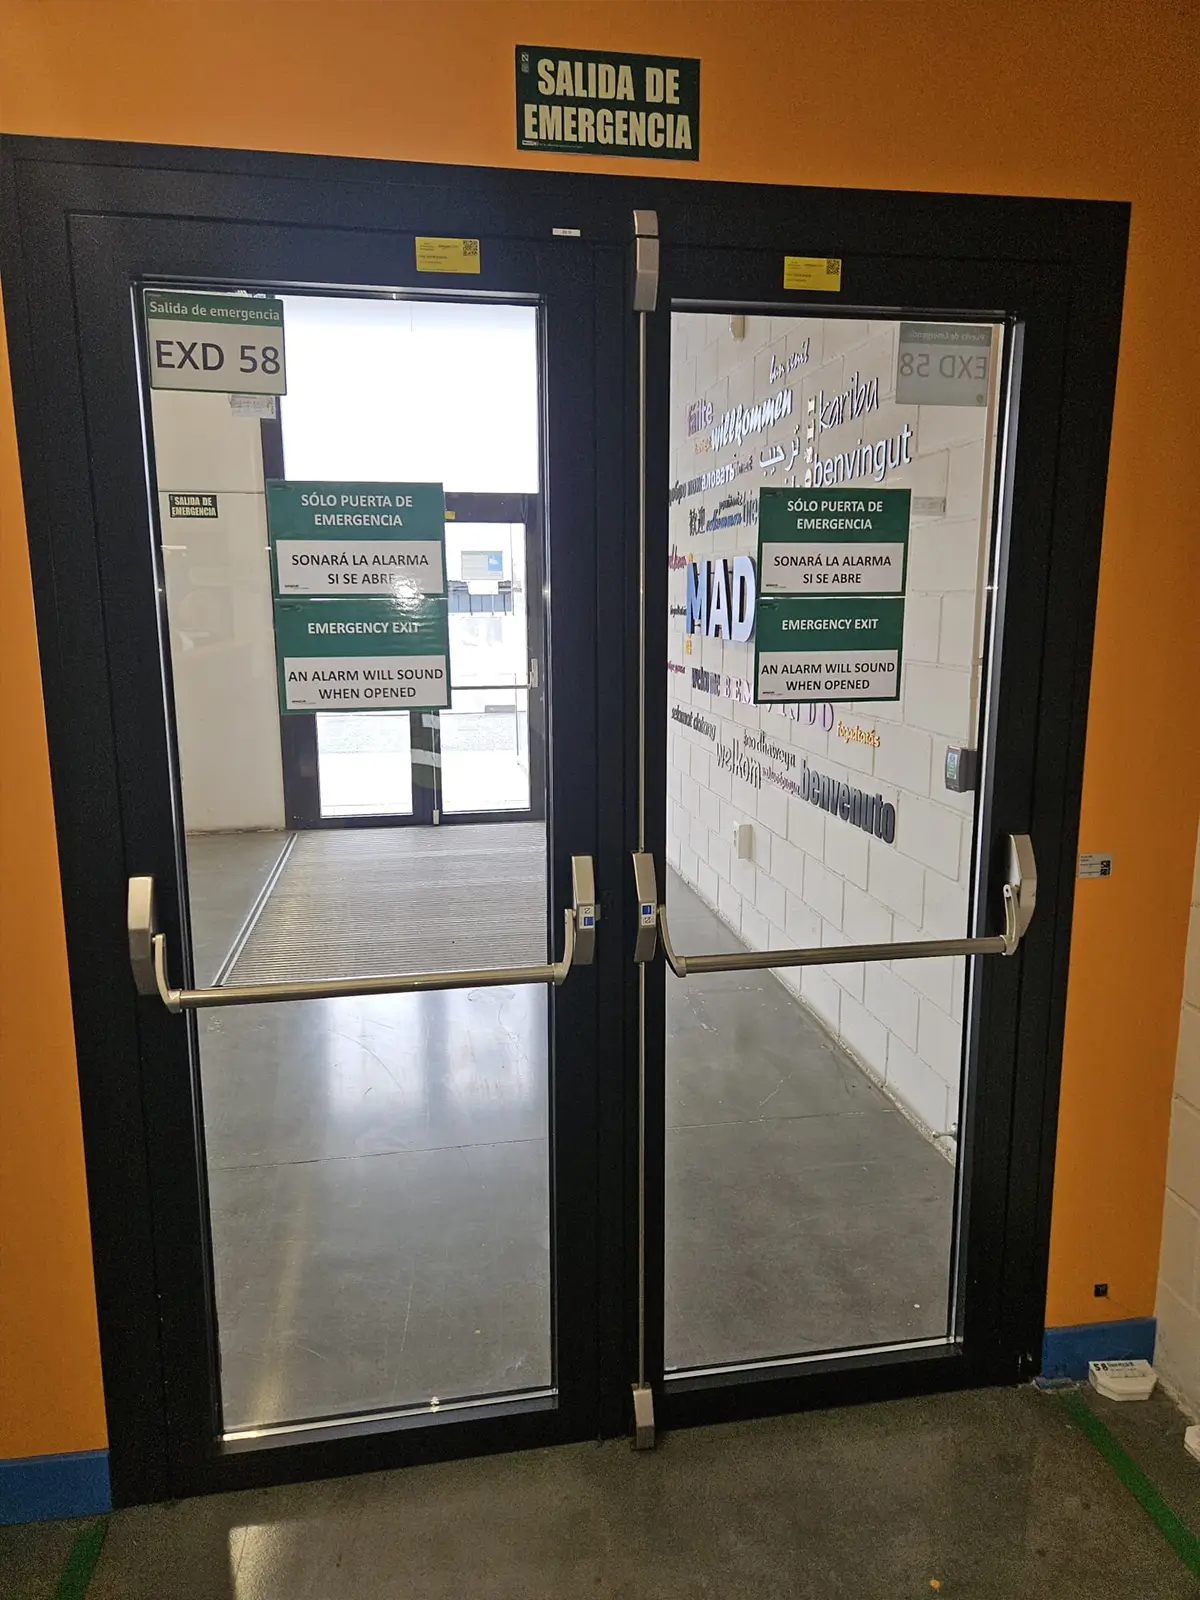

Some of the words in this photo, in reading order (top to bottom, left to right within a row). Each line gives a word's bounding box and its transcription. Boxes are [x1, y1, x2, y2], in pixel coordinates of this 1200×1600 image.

[537, 58, 635, 101] SALIDA
[645, 66, 680, 105] DE
[524, 103, 693, 150] EMERGENCIA
[150, 301, 188, 315] Salida
[191, 304, 207, 316] de
[210, 308, 280, 321] emergencia
[155, 340, 225, 371] EXD
[239, 345, 281, 375] 58
[820, 371, 879, 433] karibu
[711, 388, 793, 452] willkommen
[814, 424, 914, 488] benvingut
[174, 496, 201, 506] SALIDA
[202, 496, 213, 506] DE
[301, 492, 337, 507] SÓLO
[340, 495, 392, 508] PUERTA
[395, 496, 413, 508] DE
[787, 498, 818, 512] SÓLO
[821, 500, 865, 512] PUERTA
[868, 501, 883, 512] DE
[171, 506, 217, 517] EMERGENCIA
[314, 514, 403, 527] EMERGENCIA
[797, 518, 872, 530] EMERGENCIA
[291, 552, 348, 566] SONARÁ
[352, 554, 368, 566] LA
[372, 554, 429, 566] ALARMA
[774, 554, 823, 567] SONARÁ
[826, 556, 839, 566] LA
[842, 556, 891, 566] ALARMA
[328, 573, 339, 585] SI
[343, 573, 358, 585] SE
[803, 573, 813, 584] SI
[816, 573, 829, 584] SE
[832, 573, 862, 584] ABRE
[686, 555, 757, 642] MAD
[308, 622, 389, 634] EMERGENCY
[392, 622, 420, 634] EXIT
[782, 619, 852, 631] EMERGENCY
[854, 618, 879, 630] EXIT
[288, 671, 308, 682] AN
[312, 670, 359, 682] ALARM
[363, 670, 394, 681] WILL
[397, 668, 443, 680] SOUND
[761, 664, 778, 675] AN
[781, 663, 822, 674] ALARM
[825, 663, 852, 673] WILL
[854, 662, 895, 673] SOUND
[691, 666, 721, 697] welcome
[786, 680, 821, 691] WHEN
[824, 679, 870, 690] OPENED
[318, 688, 360, 699] WHEN
[364, 687, 416, 698] OPENED
[716, 738, 761, 790] welkom
[801, 759, 896, 844] benvenuto
